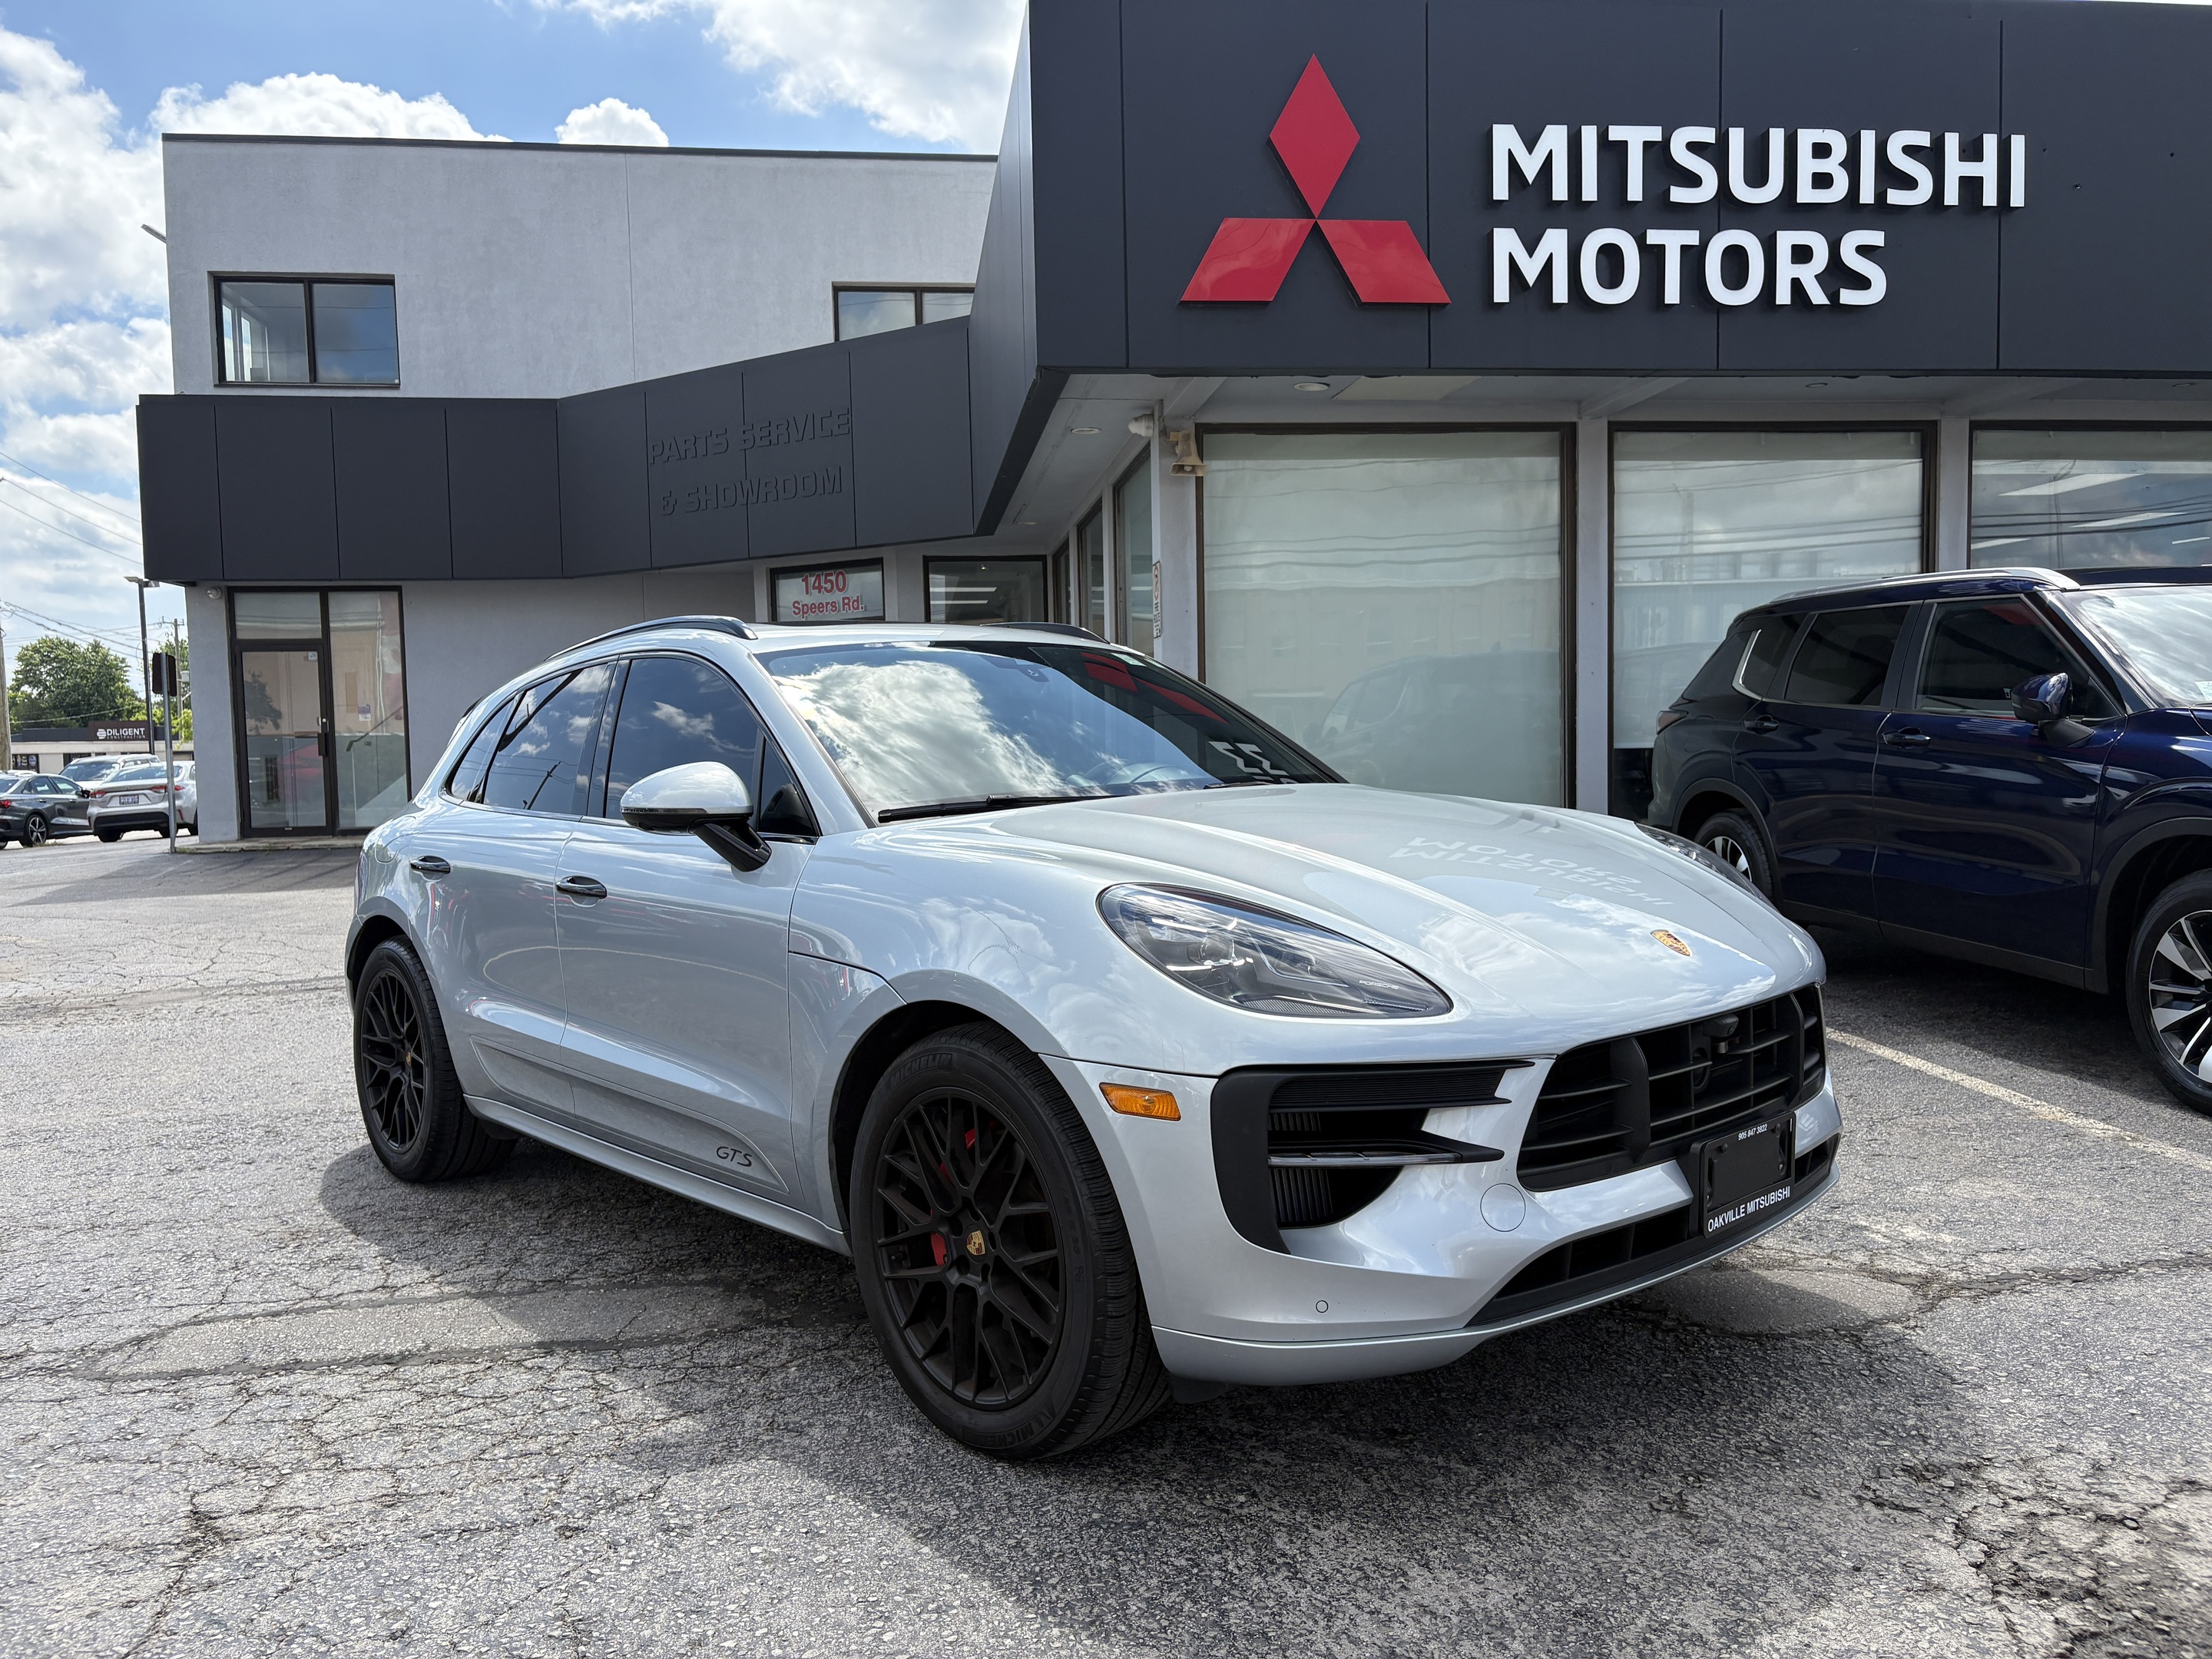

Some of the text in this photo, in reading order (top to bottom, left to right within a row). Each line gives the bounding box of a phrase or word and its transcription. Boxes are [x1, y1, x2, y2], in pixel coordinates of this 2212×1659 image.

[1492, 124, 2025, 207] MITSUBISHI
[1492, 227, 1887, 306] MOTORS
[649, 407, 850, 468] PARTS SERVICE
[660, 465, 843, 517] & SHOWROOM
[801, 570, 847, 596] 1450
[792, 594, 865, 621] Speers Rd.
[107, 727, 145, 736] DILIGENT
[1359, 979, 1399, 990] PORSCHE
[716, 1146, 753, 1167] GTS
[1707, 1186, 1791, 1233] OAKVILLE MITSUBISHI
